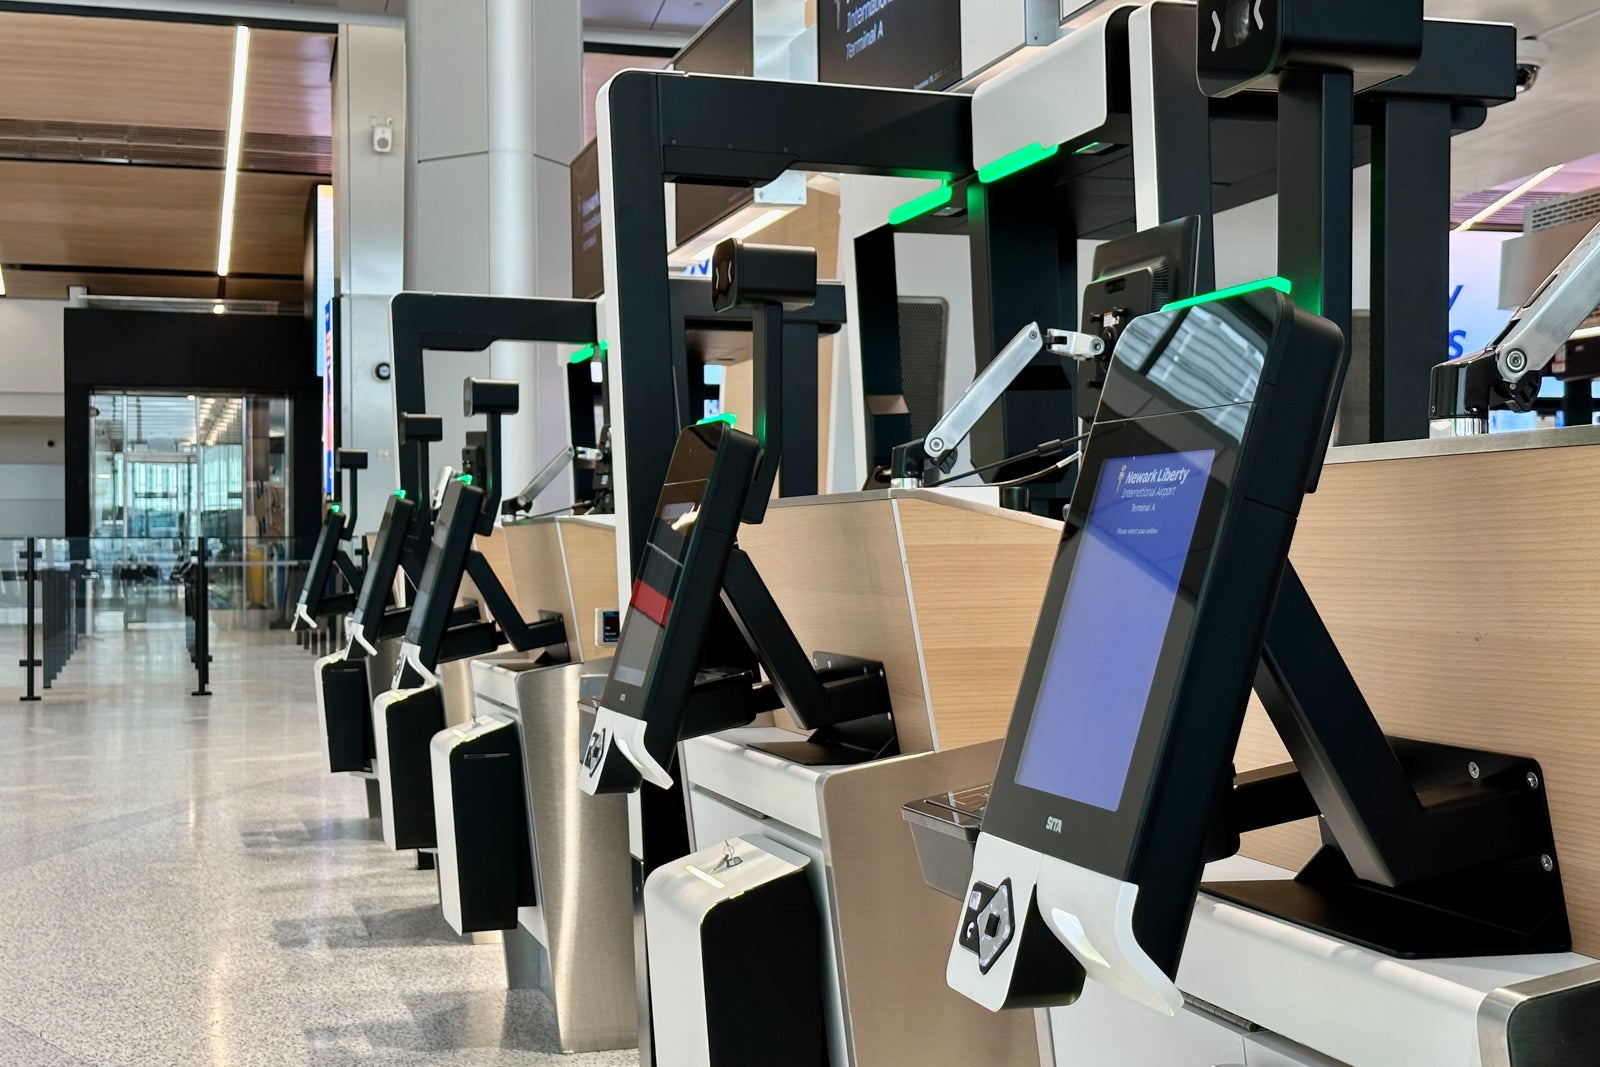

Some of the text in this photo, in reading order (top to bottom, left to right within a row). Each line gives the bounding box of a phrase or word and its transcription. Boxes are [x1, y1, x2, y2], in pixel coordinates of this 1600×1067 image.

[846, 0, 893, 33] Internatio
[846, 20, 884, 60] Terminal A
[1125, 467, 1190, 485] Newark Liberty
[1121, 486, 1176, 498] International Airport
[1131, 502, 1156, 512] Terminal A
[1045, 816, 1063, 834] SITA
